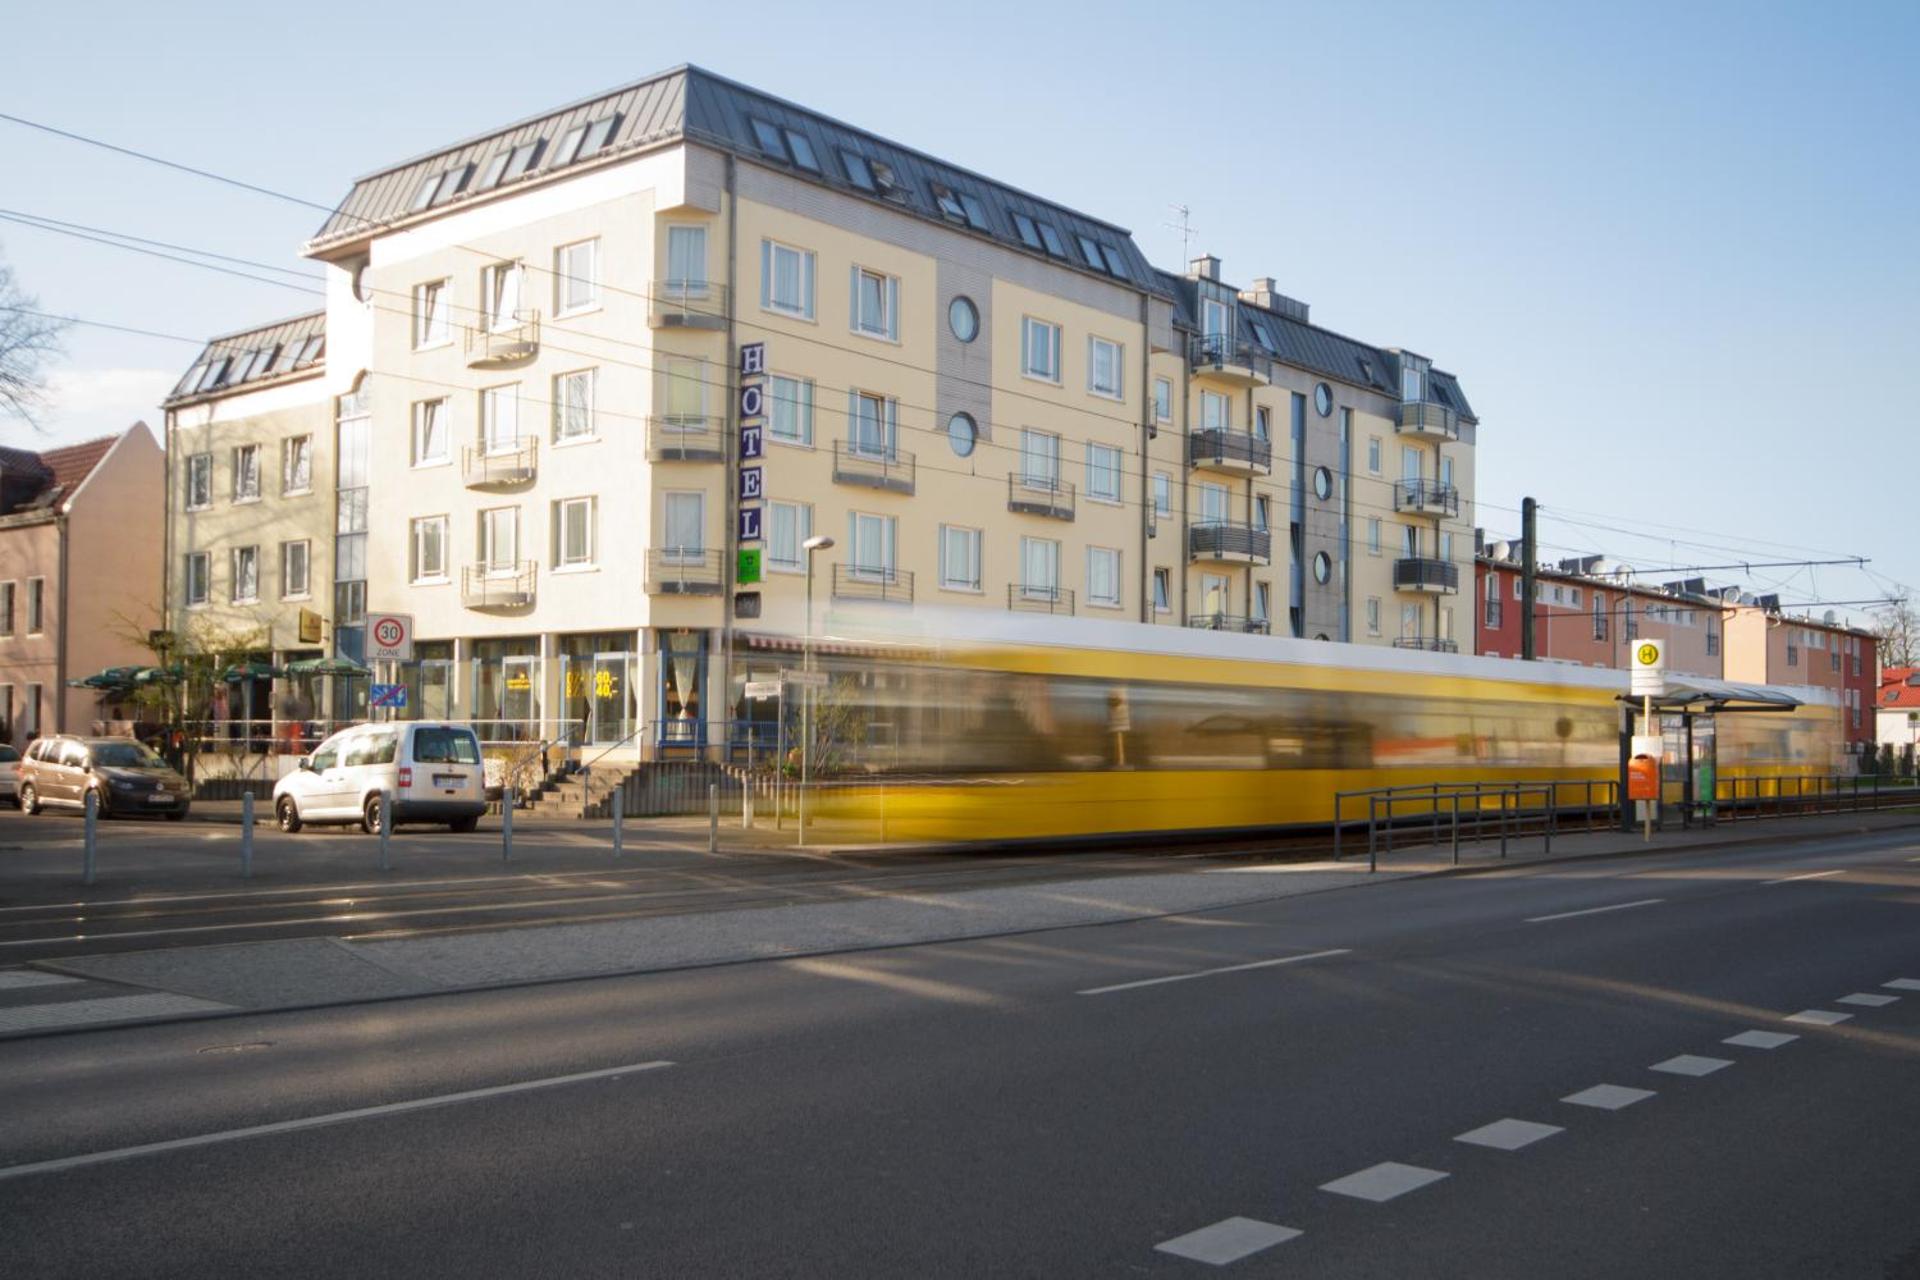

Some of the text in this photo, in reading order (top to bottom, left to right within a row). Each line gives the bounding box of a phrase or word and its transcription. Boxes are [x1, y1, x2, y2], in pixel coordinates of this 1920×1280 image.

[742, 346, 763, 538] HOTEL
[381, 625, 398, 639] 30
[376, 648, 400, 657] ZONE
